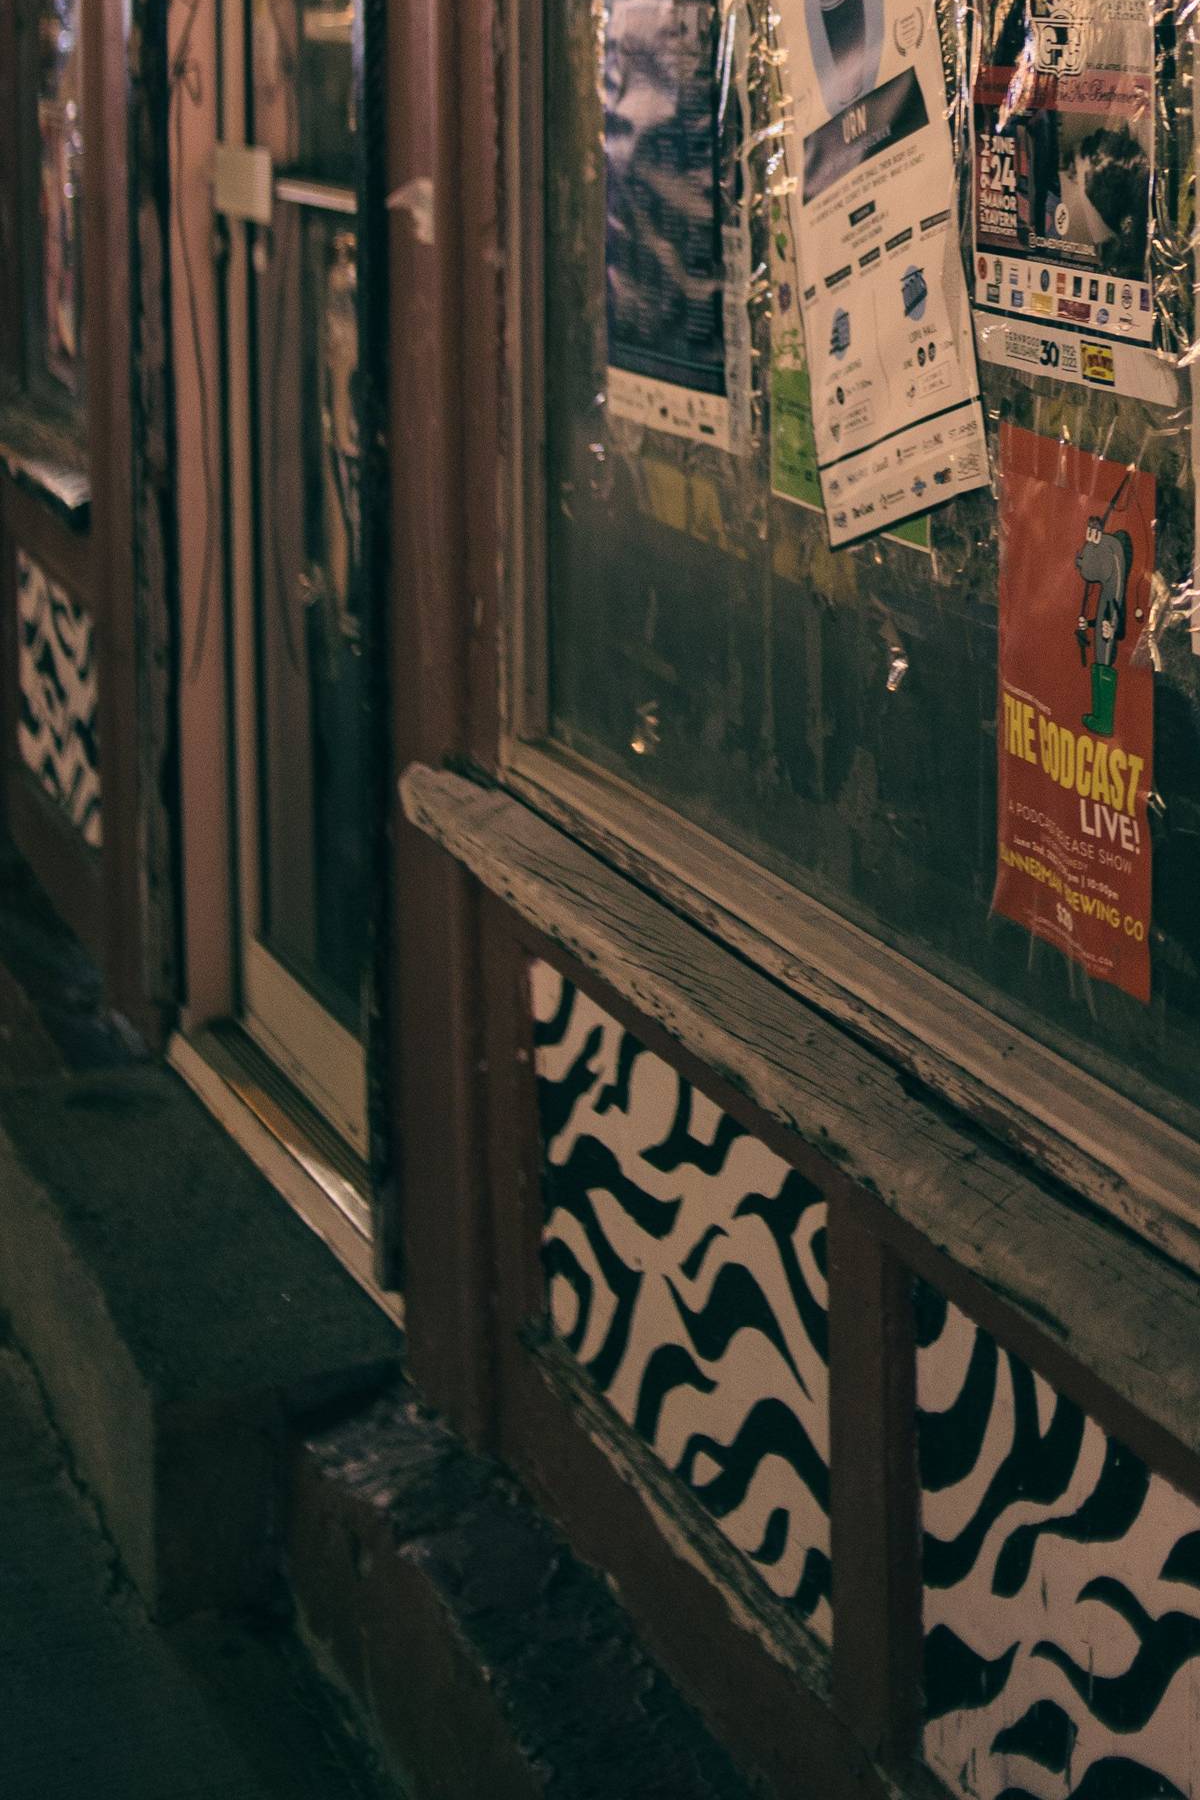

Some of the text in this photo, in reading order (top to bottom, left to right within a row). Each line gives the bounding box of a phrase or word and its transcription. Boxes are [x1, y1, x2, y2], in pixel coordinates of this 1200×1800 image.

[842, 102, 867, 145] URN
[991, 135, 1016, 155] JUNE
[991, 154, 1017, 193] 24
[1040, 340, 1060, 368] 30
[1003, 691, 1038, 766] THE
[1038, 713, 1145, 819] CODCAST
[1079, 797, 1141, 856] LIVE!
[1098, 848, 1133, 876] SHOW
[1124, 914, 1144, 942] CO
